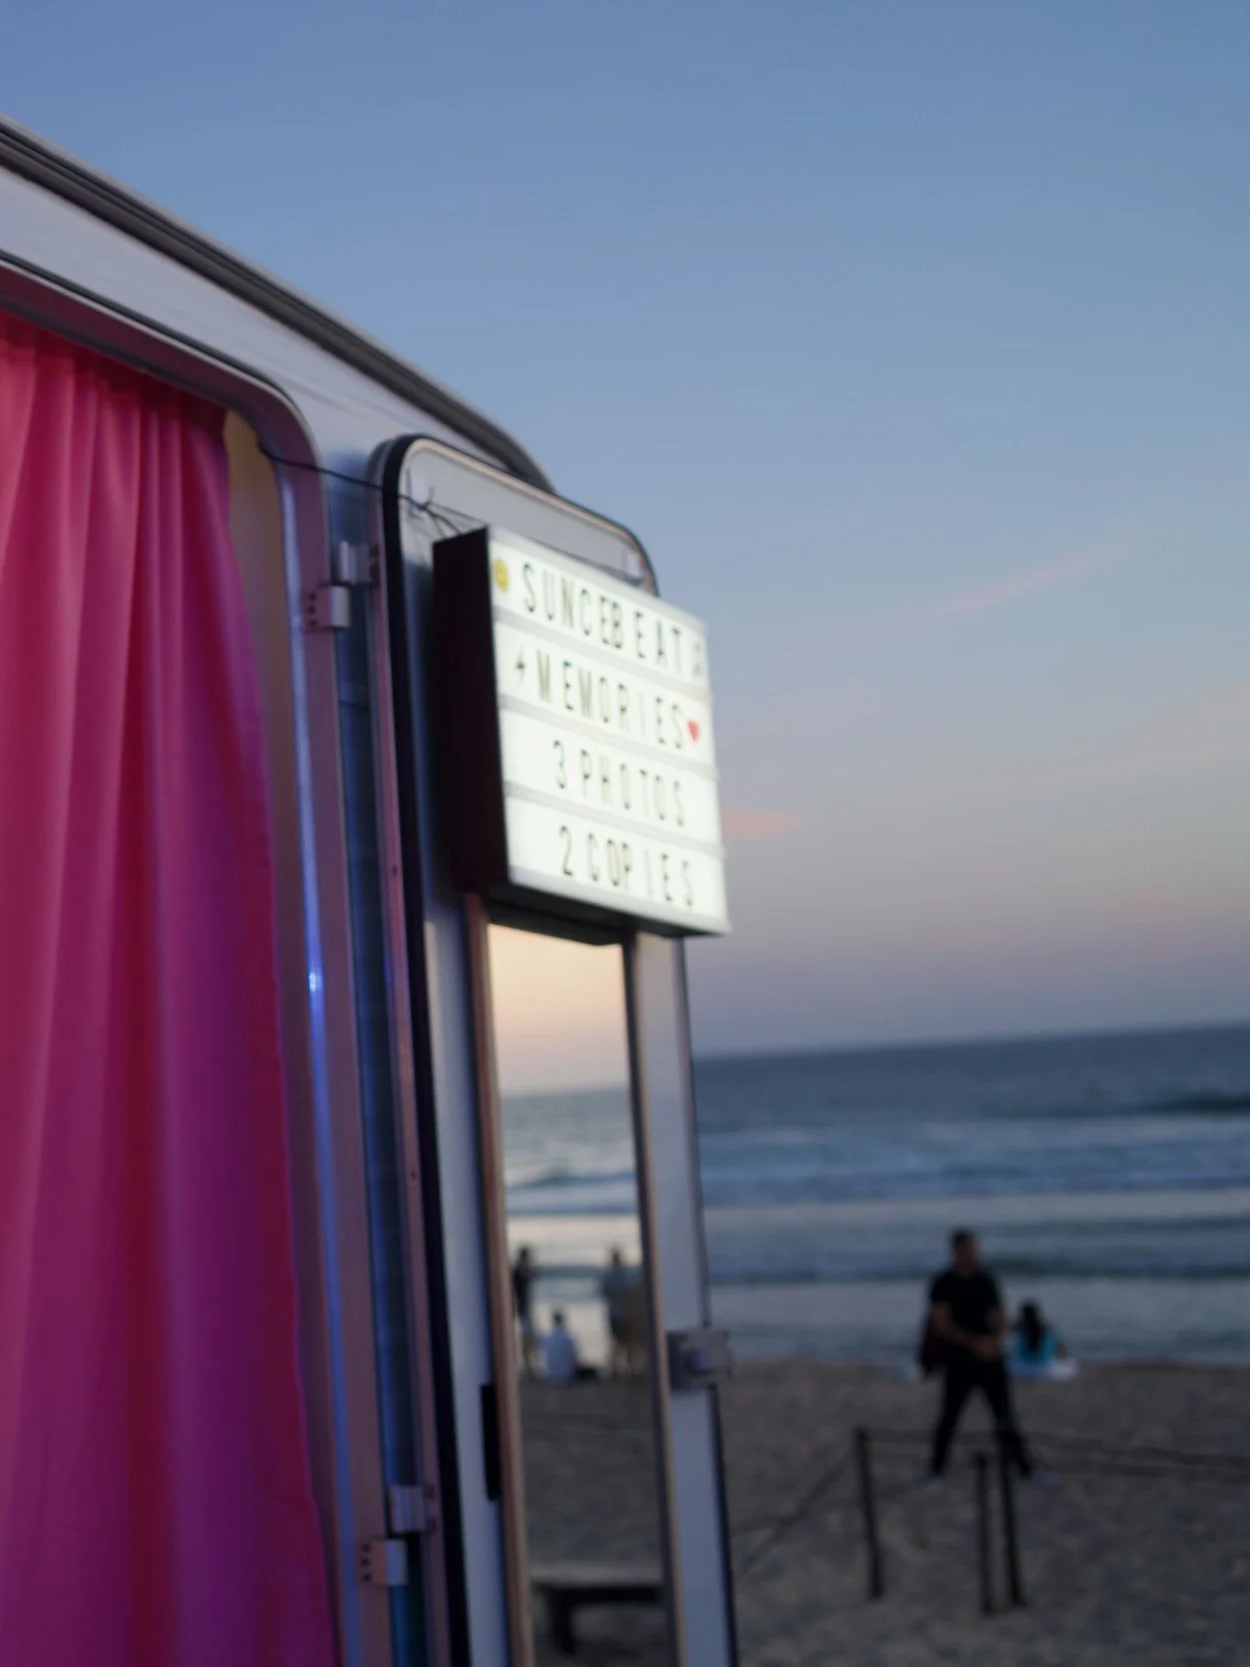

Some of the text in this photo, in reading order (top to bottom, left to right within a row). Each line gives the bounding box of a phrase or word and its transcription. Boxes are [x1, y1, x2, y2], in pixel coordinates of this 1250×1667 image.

[536, 649, 685, 750] MEMORIES
[553, 740, 685, 828] 3 PHOTOS
[559, 825, 695, 908] 2 COPIES
